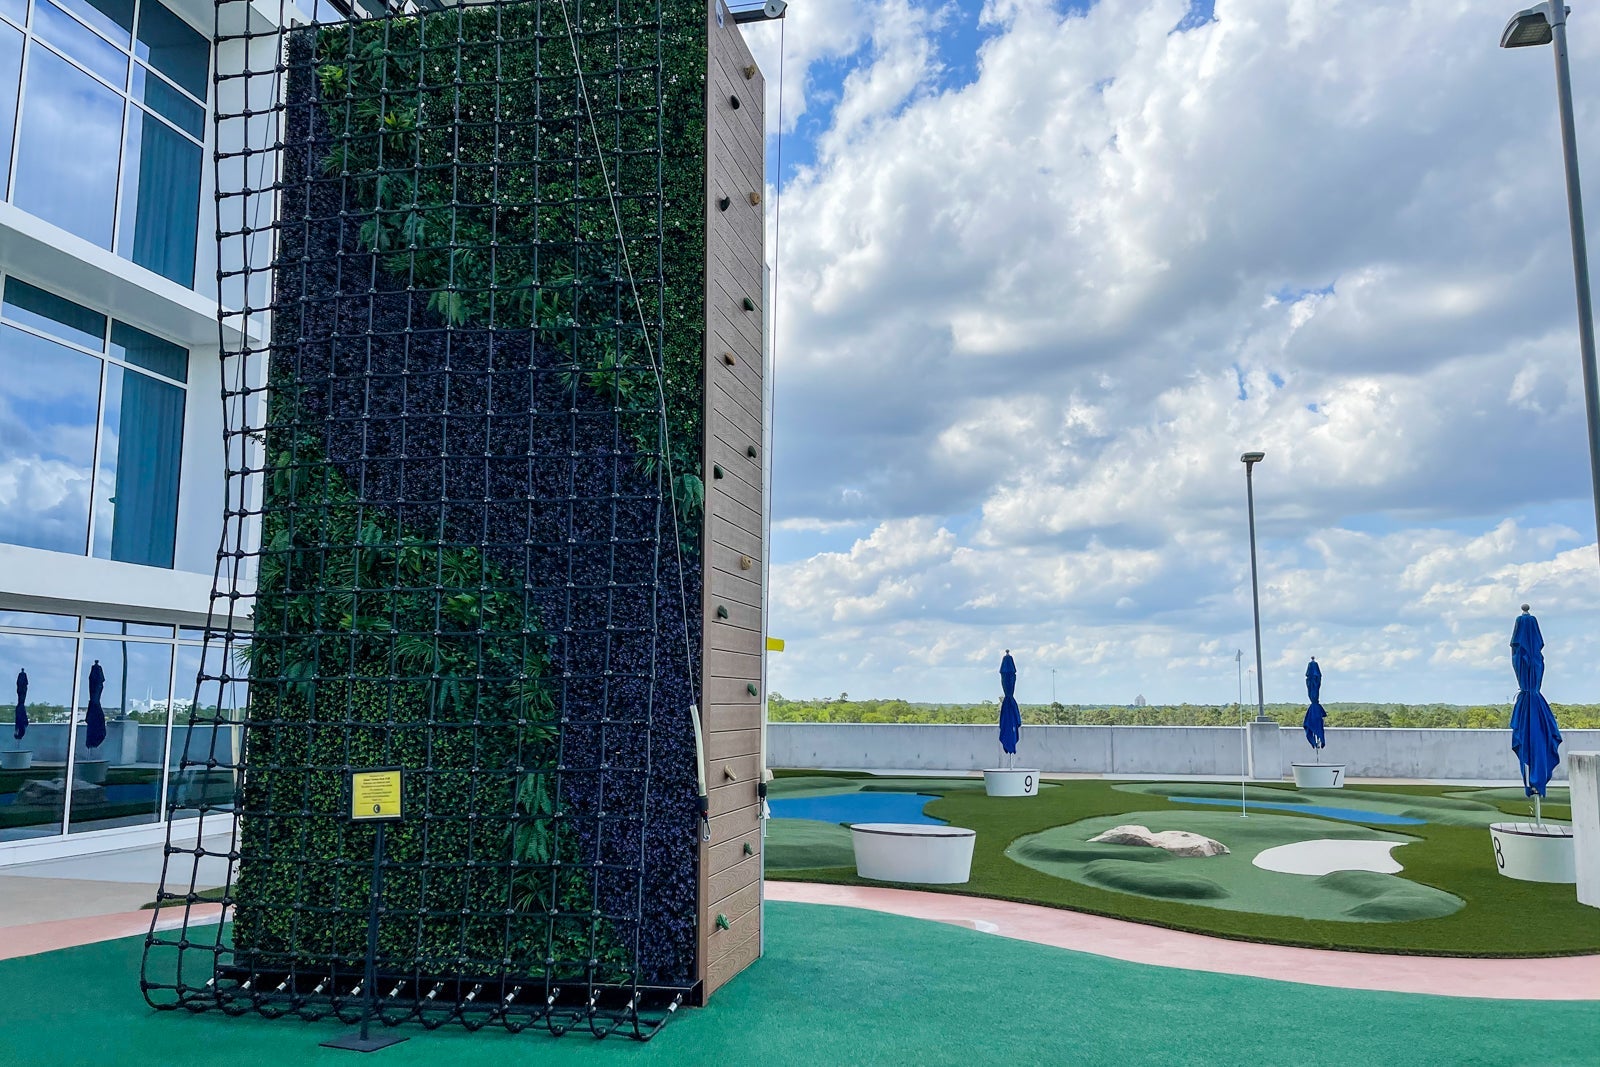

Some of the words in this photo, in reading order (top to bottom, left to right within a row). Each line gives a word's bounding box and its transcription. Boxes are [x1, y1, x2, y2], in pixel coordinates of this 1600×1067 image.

[1024, 775, 1033, 793] 9
[1332, 770, 1340, 786] 7
[1493, 836, 1505, 869] 8
